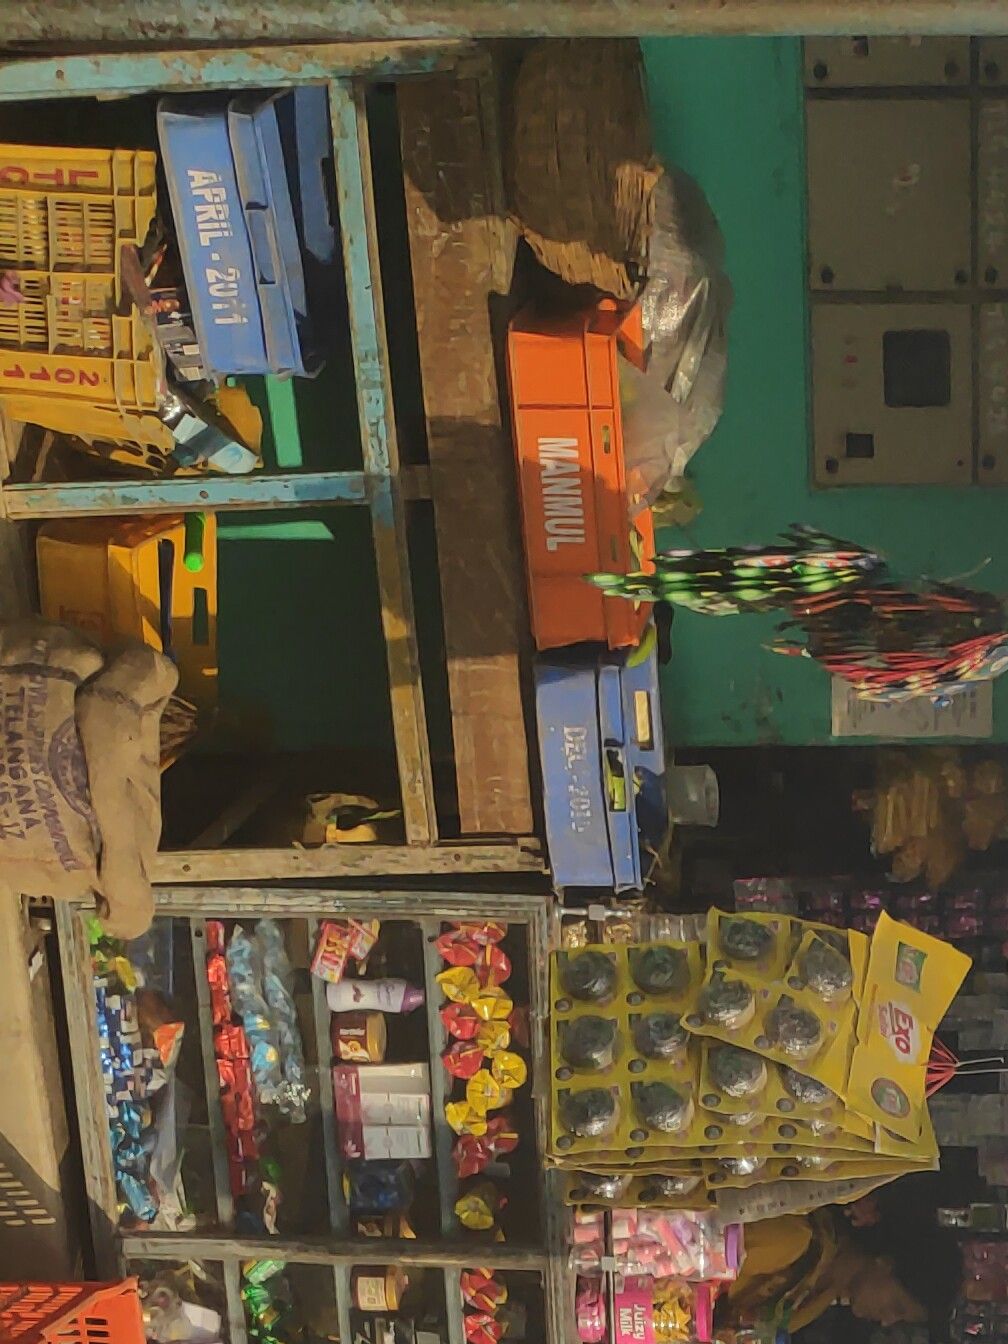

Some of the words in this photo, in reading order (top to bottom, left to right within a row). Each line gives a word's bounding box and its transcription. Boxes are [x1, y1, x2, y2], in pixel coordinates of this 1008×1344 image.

[187, 169, 234, 246] APRIL
[536, 436, 587, 552] MANMUL
[5, 686, 42, 830] TELANGANA
[618, 1307, 634, 1336] Milk
